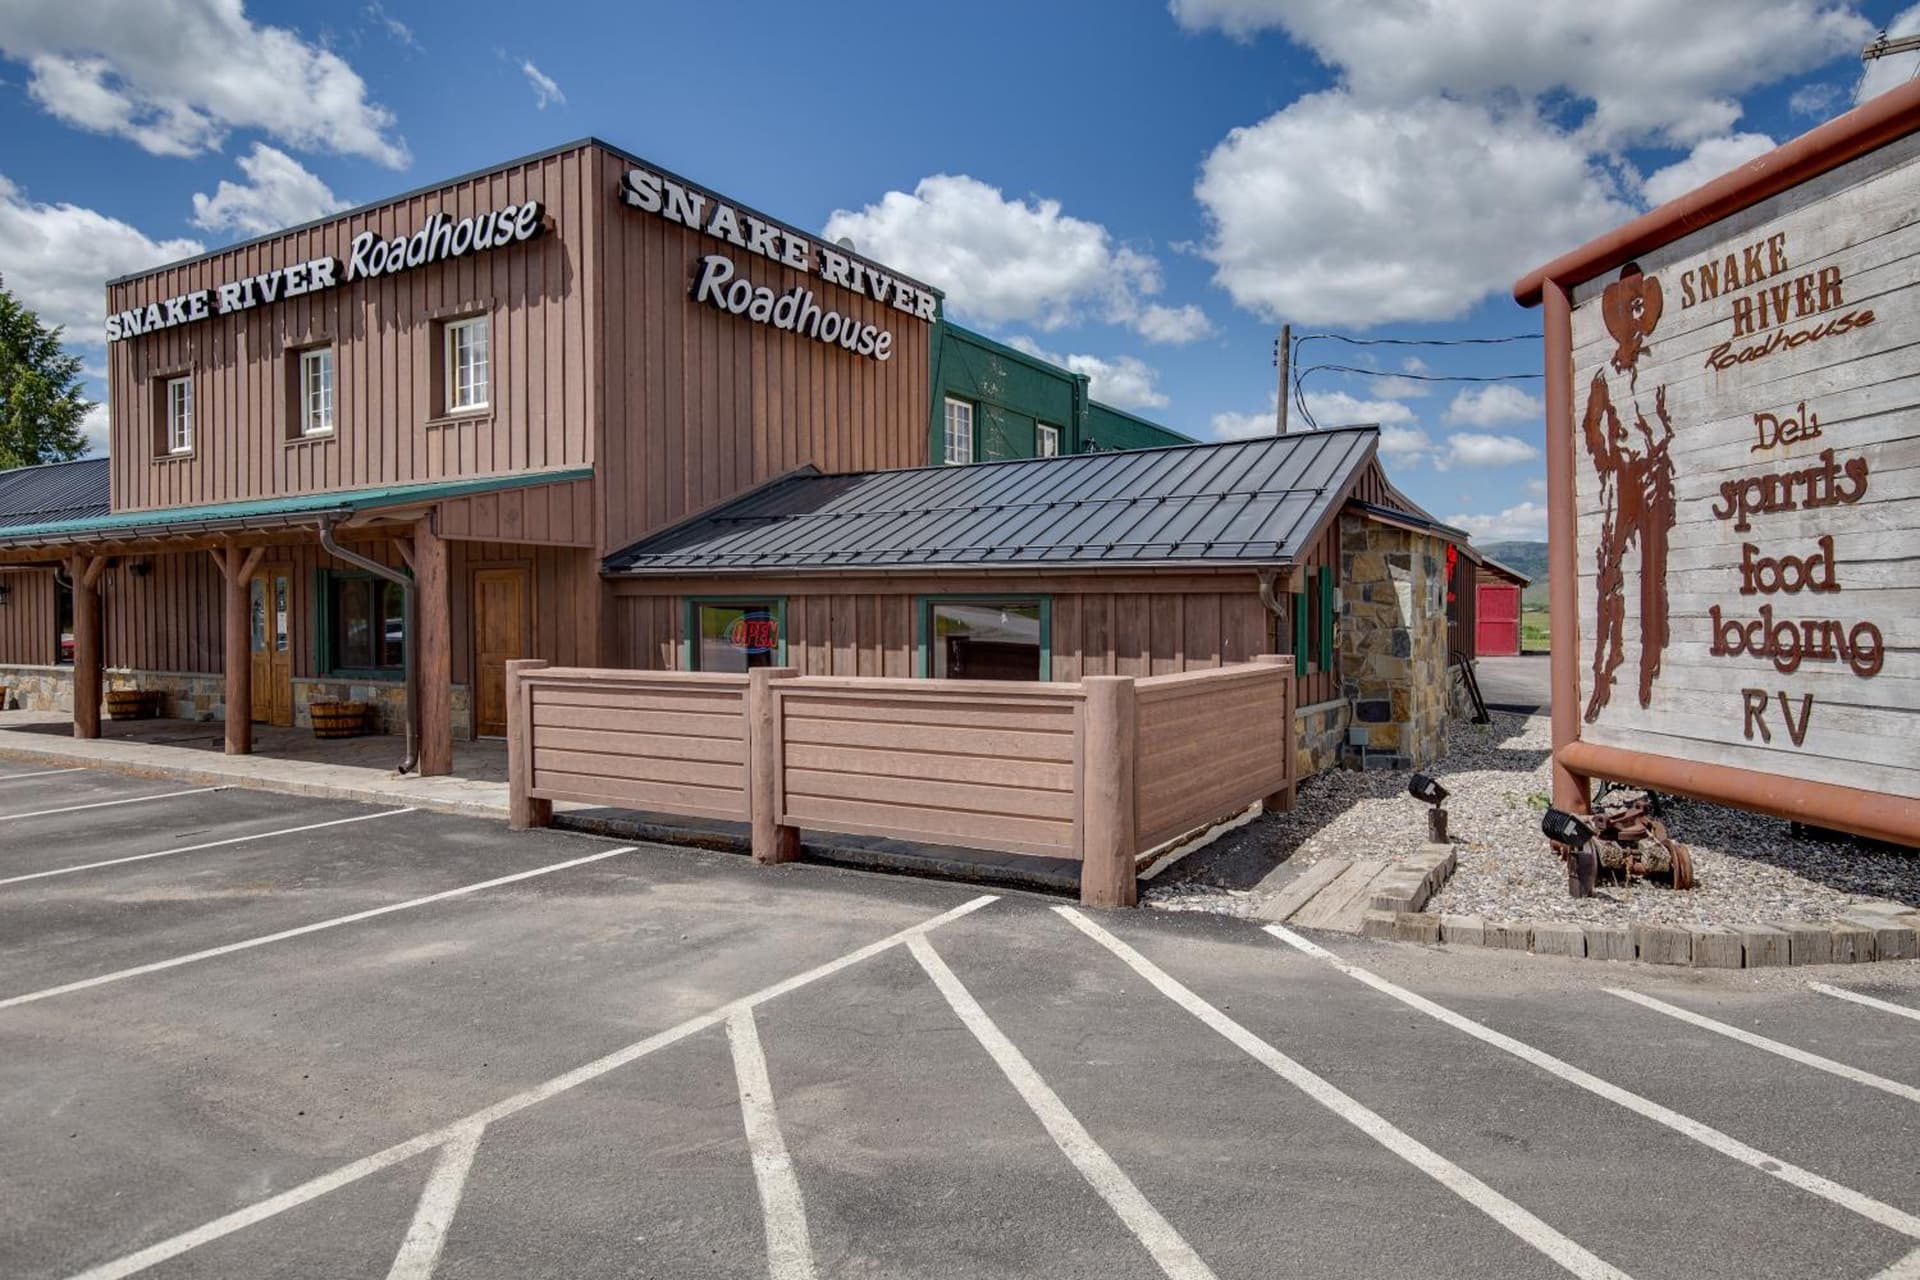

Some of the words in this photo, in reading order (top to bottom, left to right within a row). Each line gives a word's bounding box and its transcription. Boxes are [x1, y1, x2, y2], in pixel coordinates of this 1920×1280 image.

[104, 288, 209, 342] SNAKE
[218, 255, 337, 314] RIVER
[347, 200, 539, 281] Roadhouse
[627, 169, 809, 272] SNAKE
[821, 247, 937, 323] RIVER
[1680, 231, 1789, 310] SNAKE
[697, 255, 893, 361] Roadhouse
[1731, 265, 1844, 338] RIVER
[1704, 308, 1876, 371] Roadhouse
[1751, 401, 1822, 452] Deli
[1739, 535, 1841, 595] food
[731, 620, 779, 648] OPEN
[1709, 604, 1884, 677] lodging
[1741, 688, 1814, 747] RV
